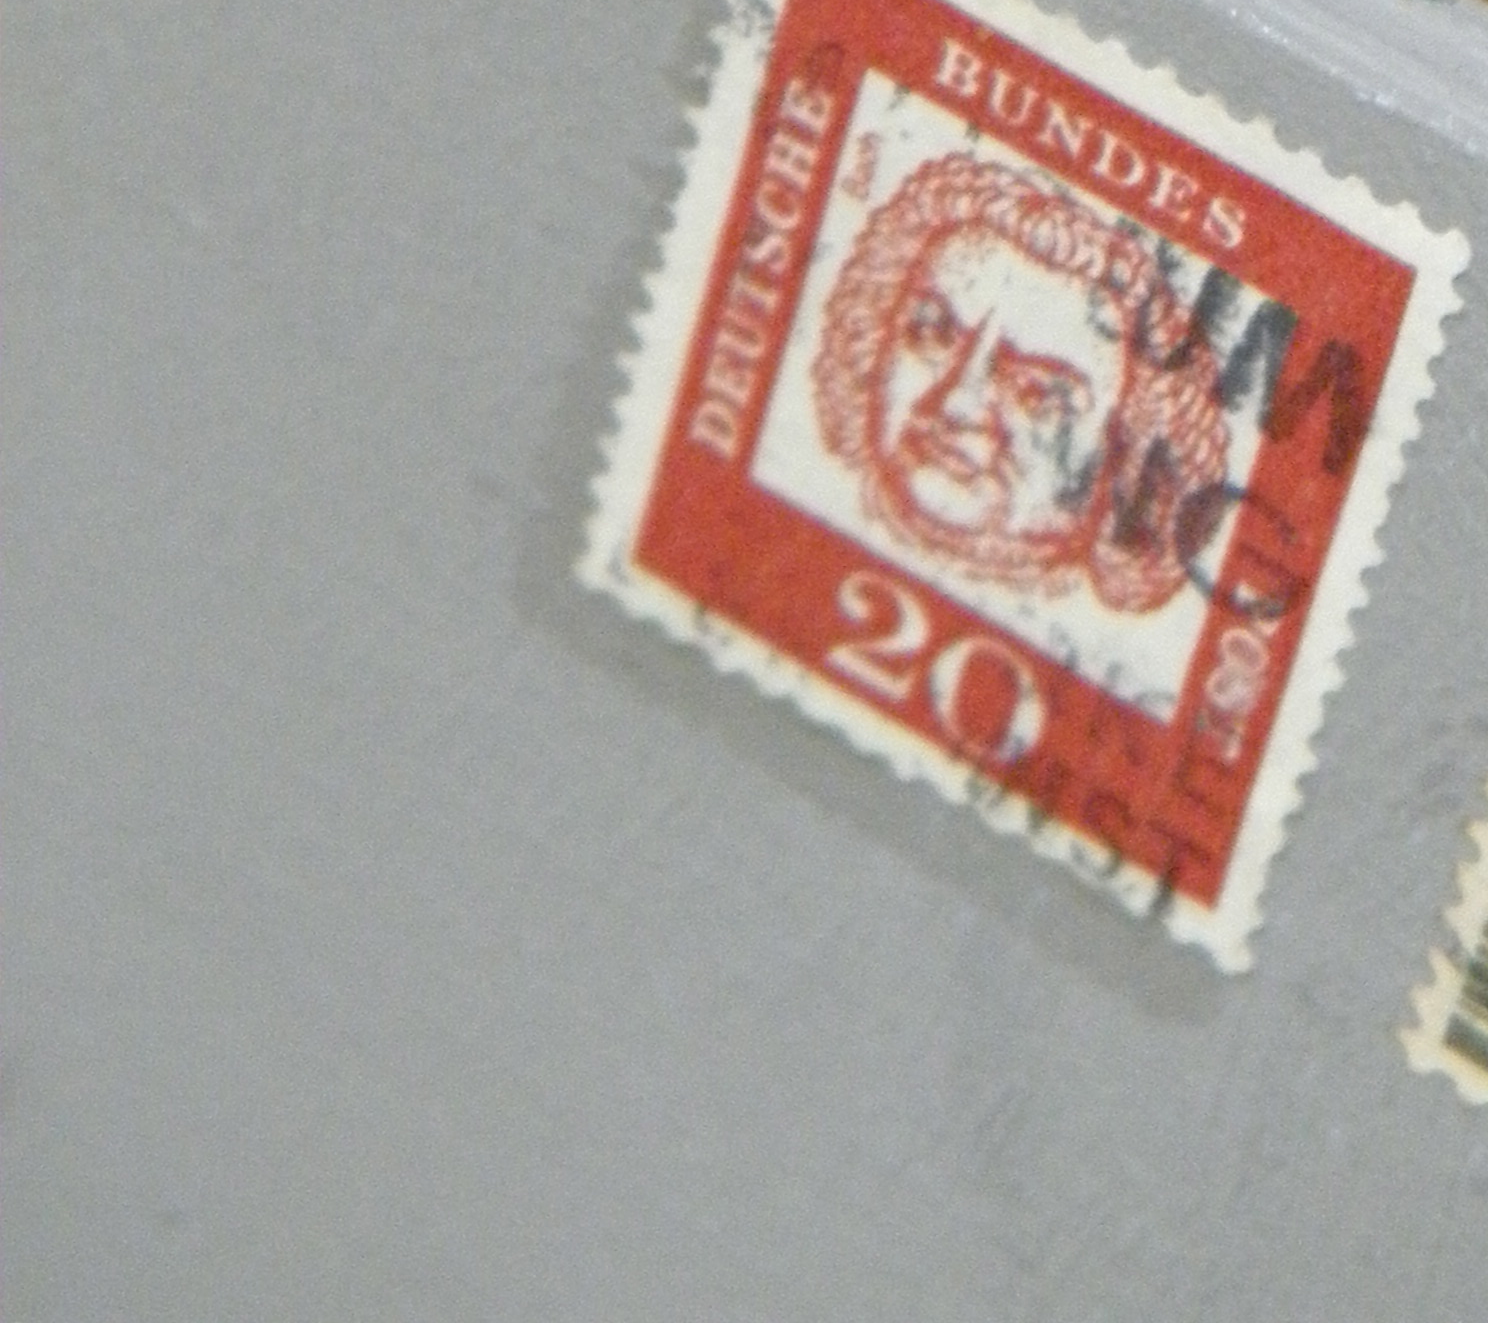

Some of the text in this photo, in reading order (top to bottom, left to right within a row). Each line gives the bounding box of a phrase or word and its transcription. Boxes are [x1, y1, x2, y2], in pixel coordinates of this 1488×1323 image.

[934, 39, 1248, 248] BUNDES
[689, 77, 833, 455] DEUTSCHE
[828, 569, 1047, 763] 20
